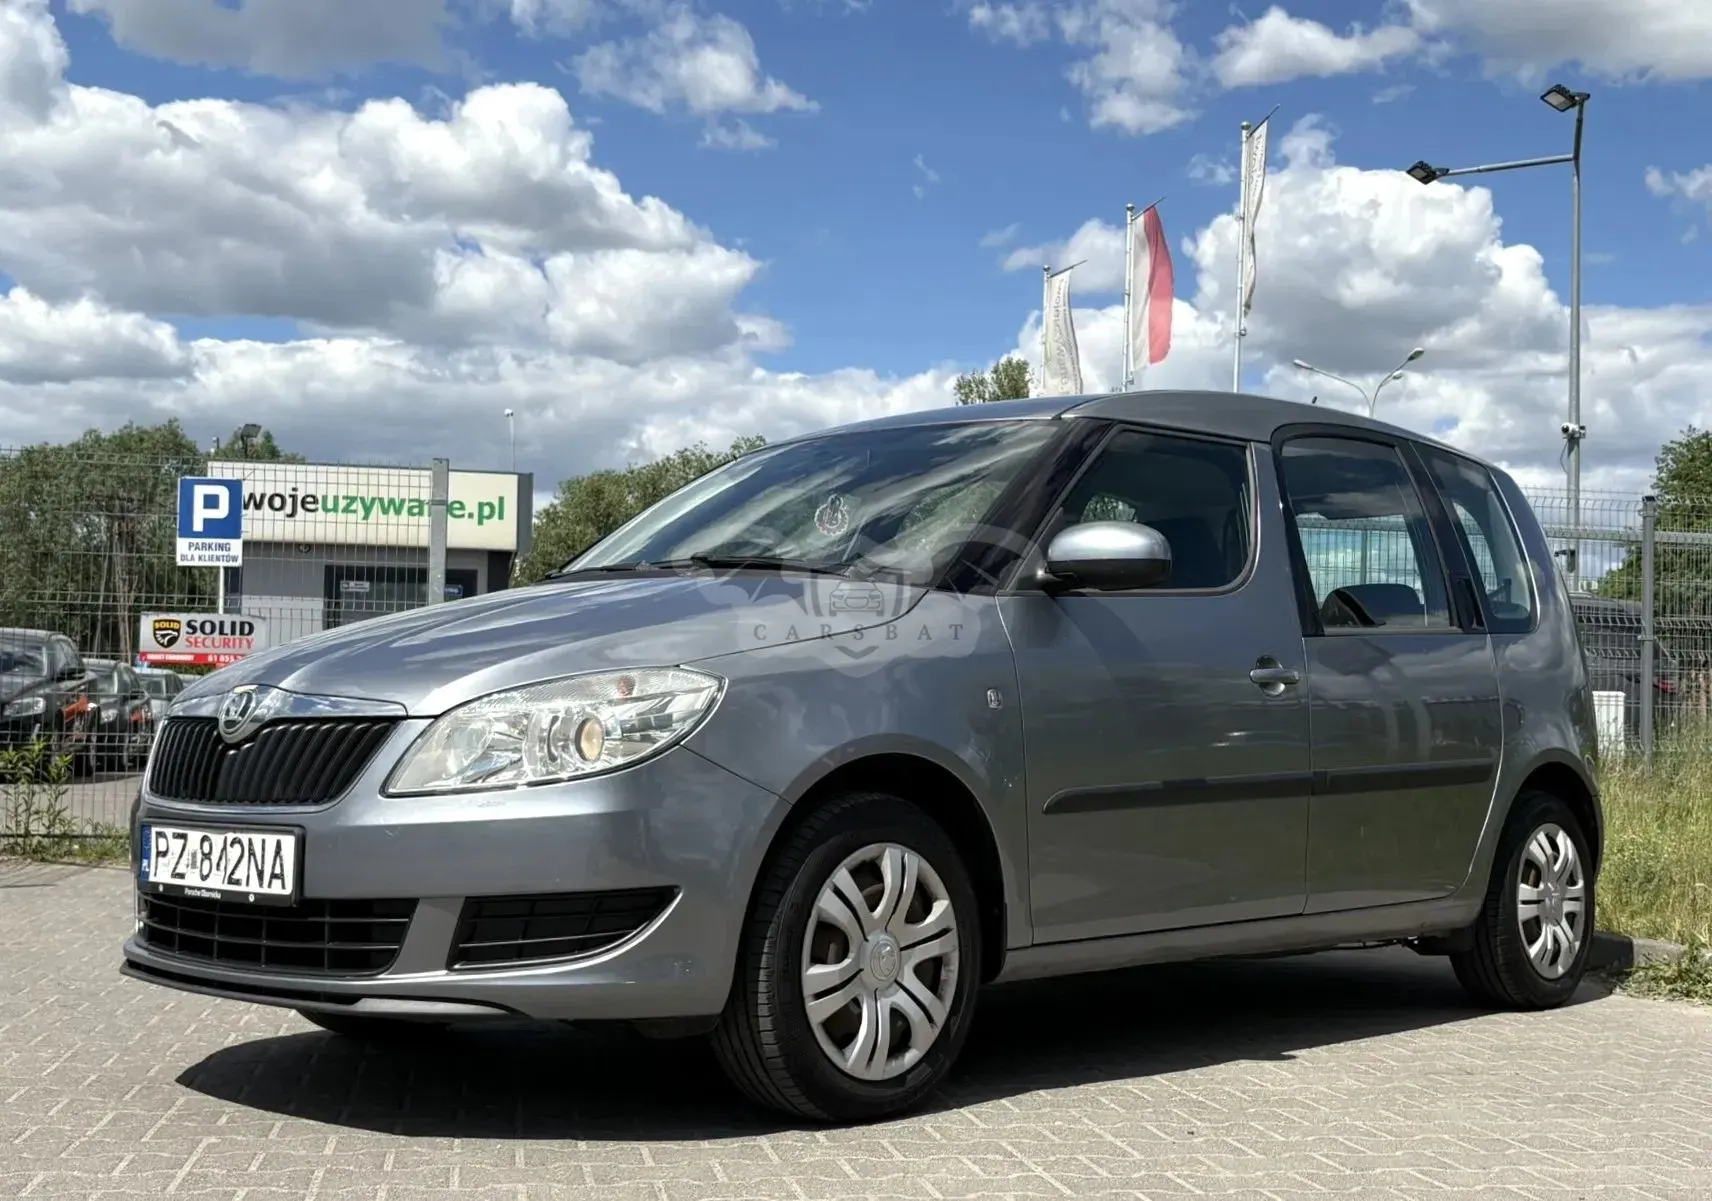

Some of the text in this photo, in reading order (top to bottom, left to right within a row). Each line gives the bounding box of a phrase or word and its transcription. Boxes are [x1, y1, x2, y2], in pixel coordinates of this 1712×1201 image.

[193, 484, 230, 532] P
[242, 487, 505, 526] wojeuzywae.pl
[188, 541, 231, 552] PARKING
[180, 553, 195, 562] DLA
[154, 621, 180, 630] SOLID
[185, 619, 255, 636] SOLID
[185, 635, 254, 649] SECURITY
